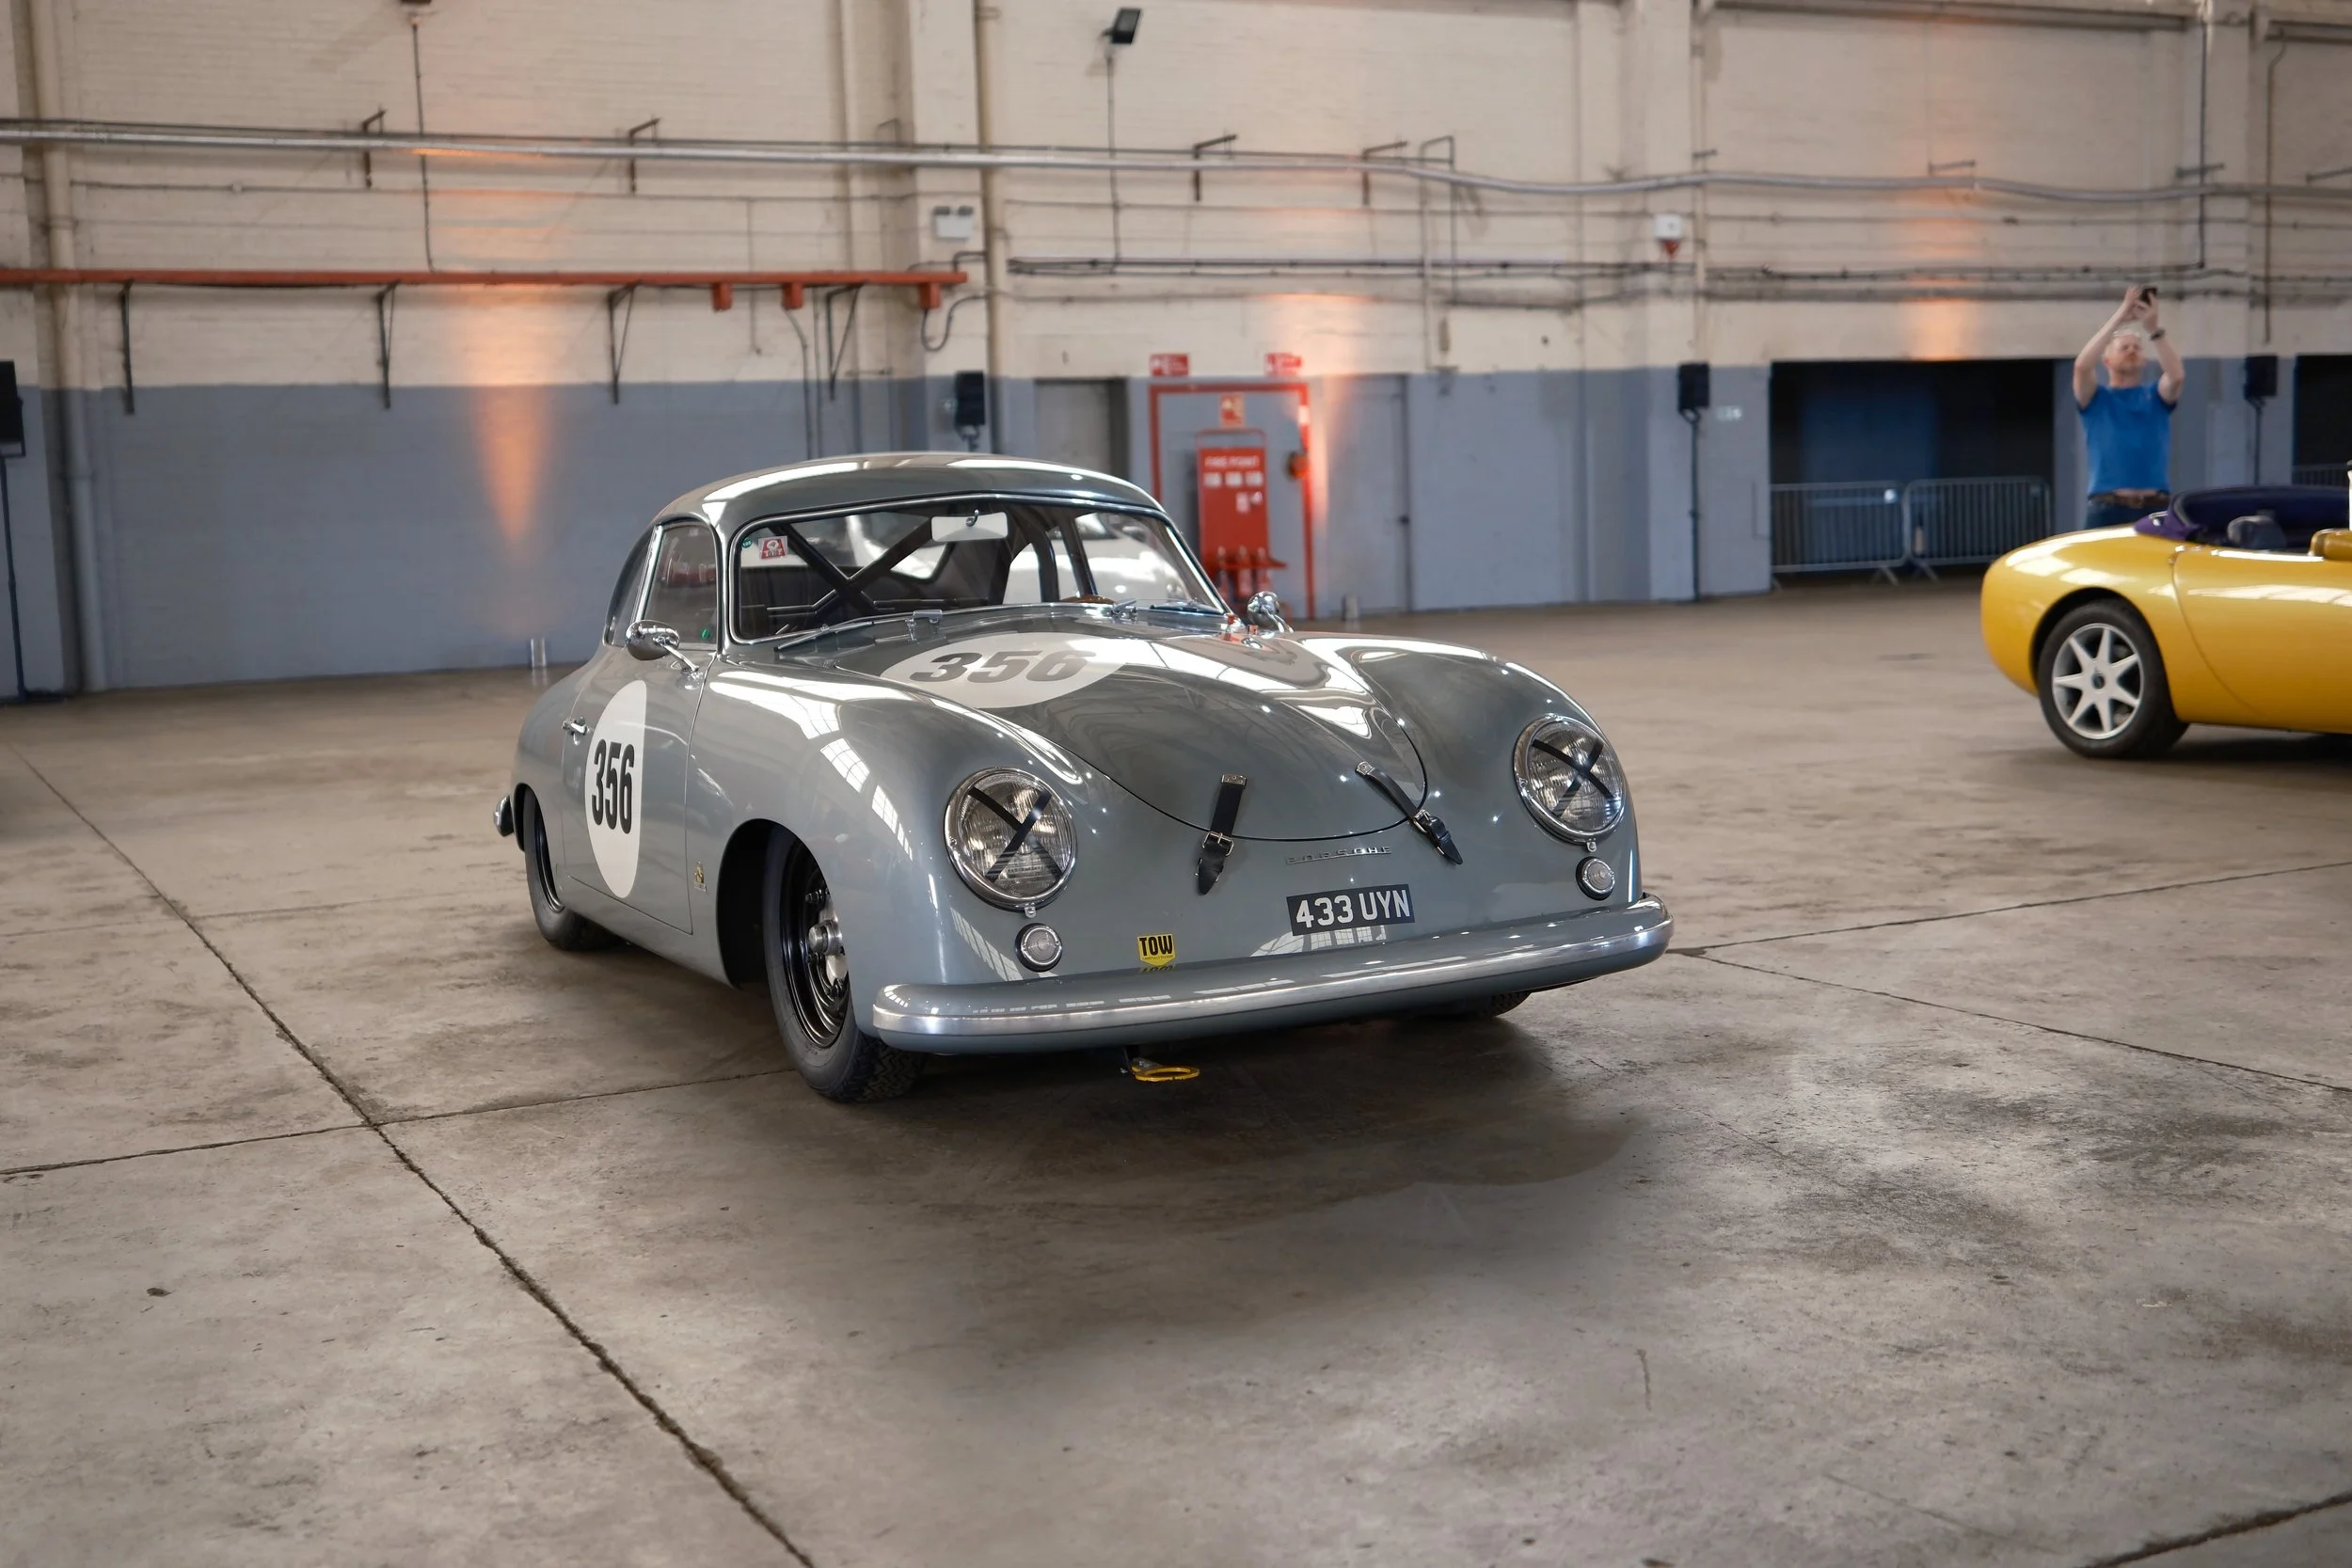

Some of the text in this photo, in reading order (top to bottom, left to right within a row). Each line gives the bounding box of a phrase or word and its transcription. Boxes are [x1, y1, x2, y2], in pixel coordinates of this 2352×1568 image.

[909, 649, 1097, 684] 356
[591, 738, 635, 834] 356
[1295, 889, 1410, 928] 433 UYN
[1138, 935, 1173, 957] TOW
